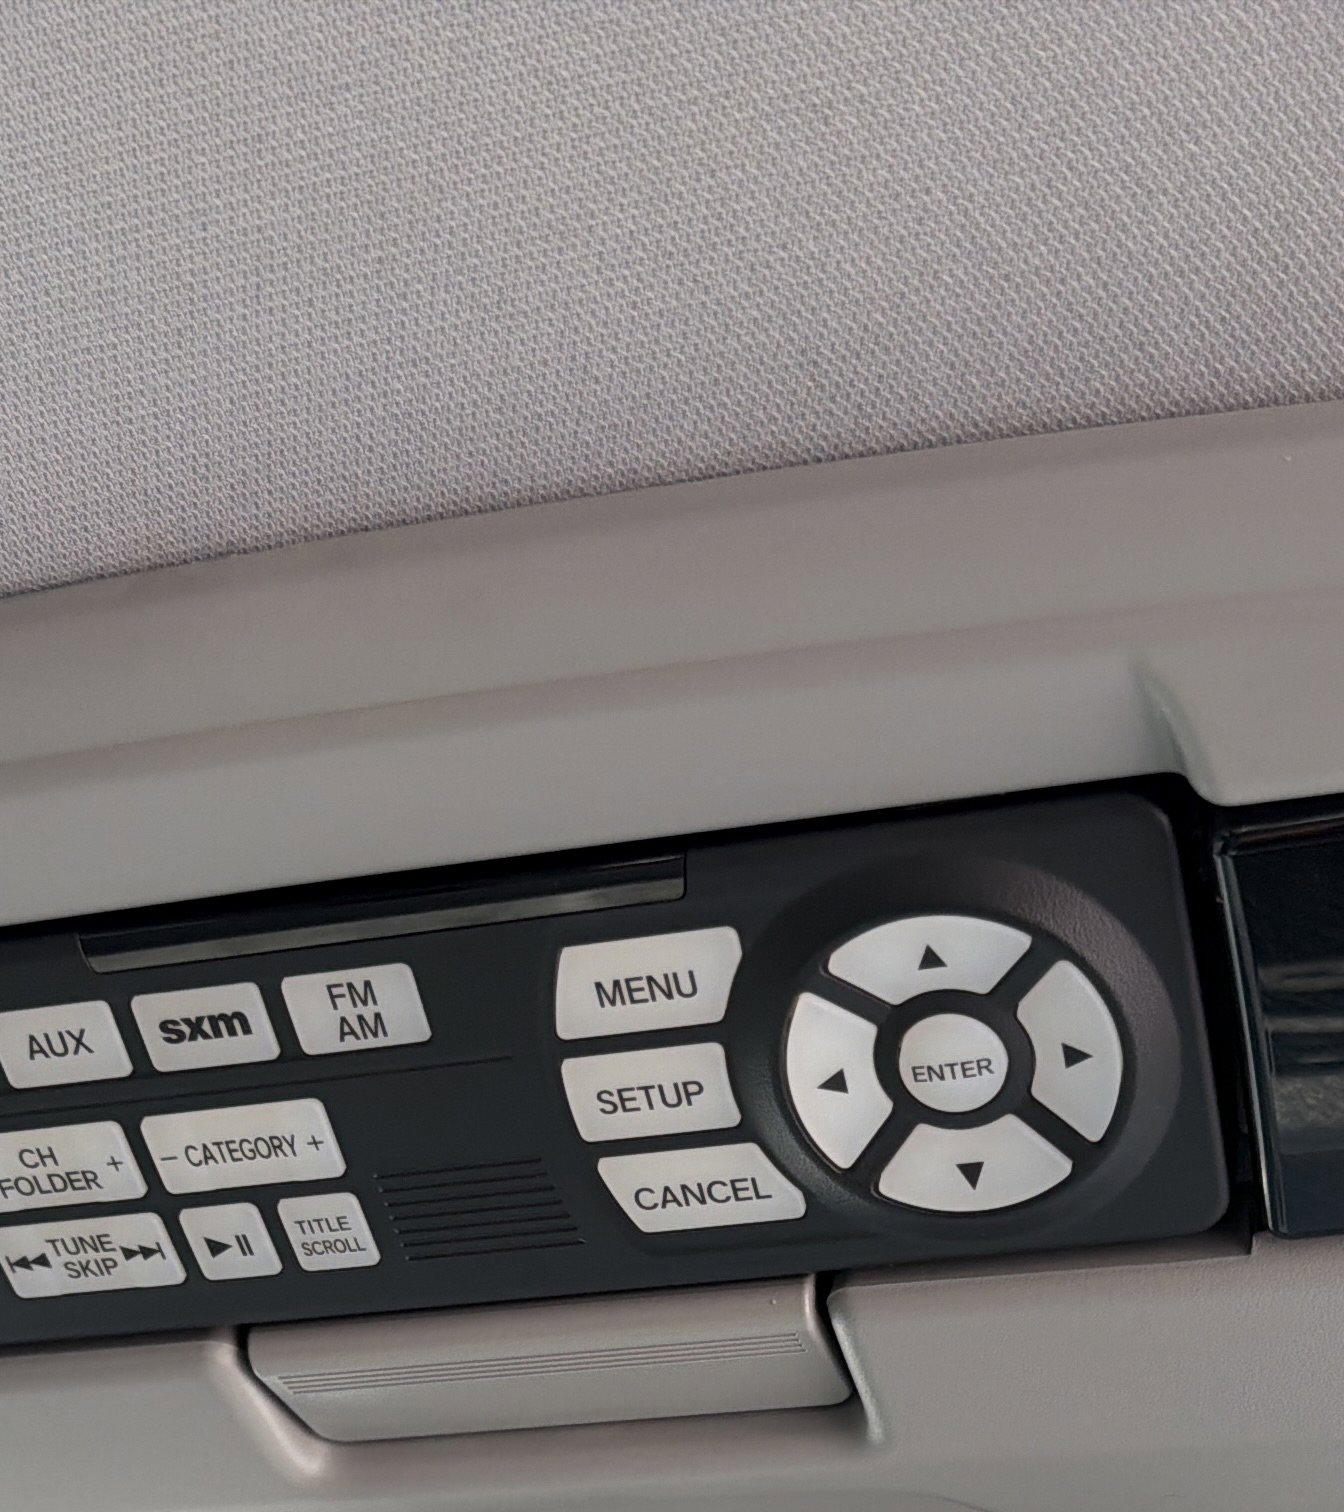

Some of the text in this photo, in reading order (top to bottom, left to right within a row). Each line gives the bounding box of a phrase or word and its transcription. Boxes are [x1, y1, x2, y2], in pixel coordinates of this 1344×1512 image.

[326, 979, 378, 1011] FM
[594, 969, 698, 1009] MENU
[158, 1011, 253, 1045] sxm
[339, 1011, 389, 1043] AM
[28, 1028, 95, 1061] AUX
[911, 1057, 994, 1083] ENTER
[596, 1080, 704, 1115] SETUP
[18, 1146, 59, 1169] CH
[184, 1134, 297, 1167] CATEGORY
[634, 1176, 773, 1211] CANCEL
[294, 1215, 352, 1236] TITLE
[47, 1234, 117, 1255] TUNE
[300, 1237, 367, 1257] SCROLL
[63, 1257, 119, 1279] SKIP
